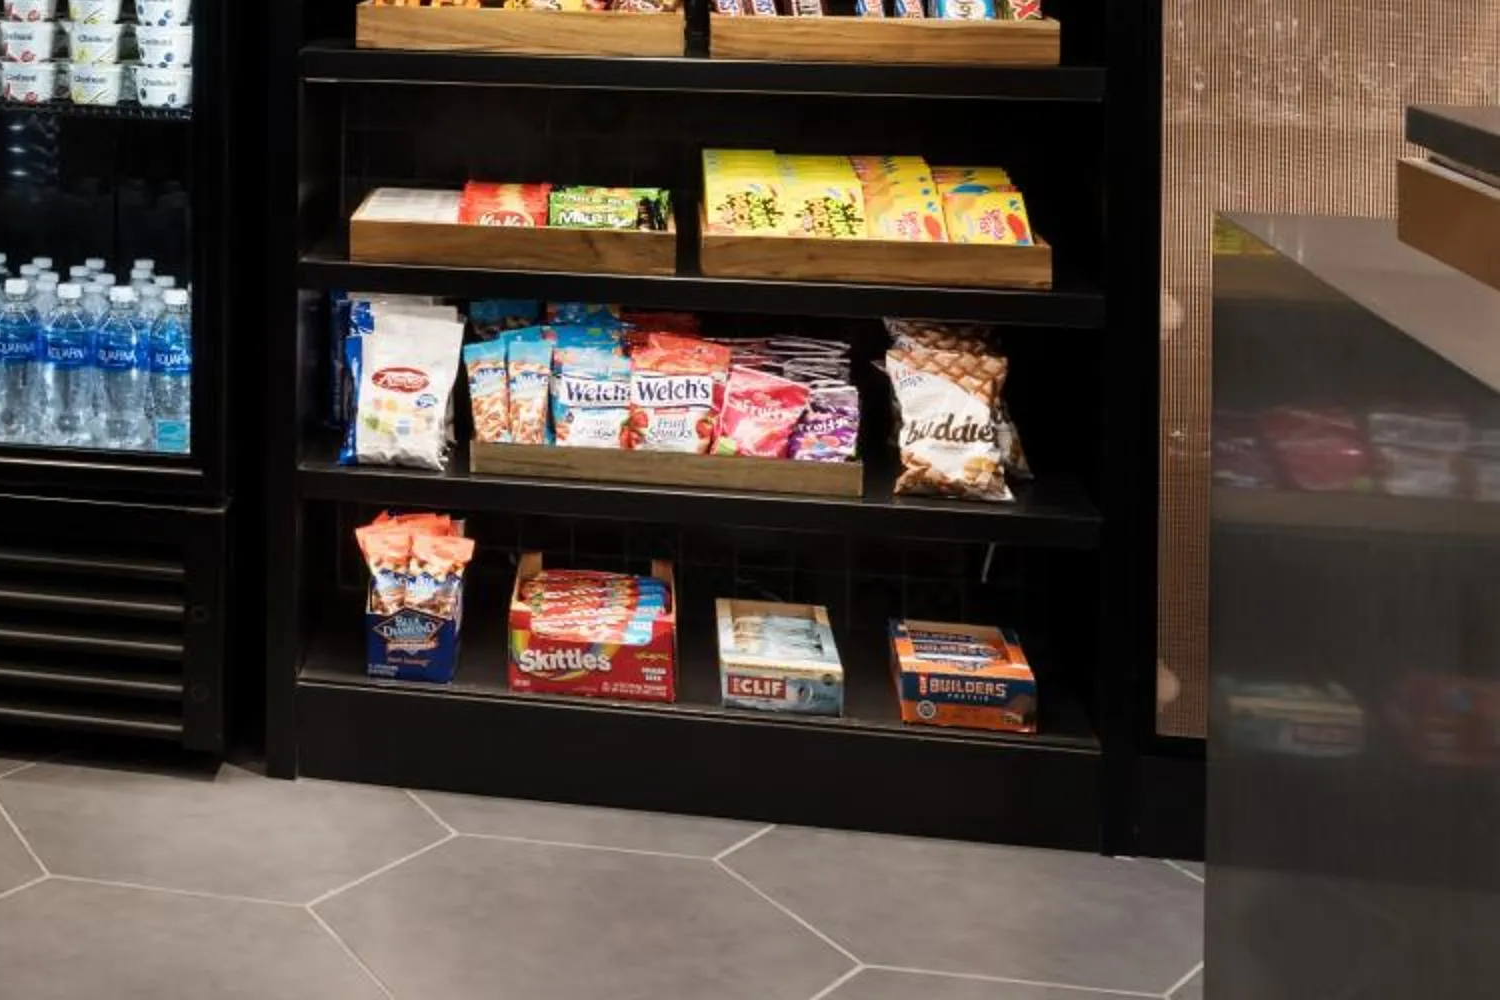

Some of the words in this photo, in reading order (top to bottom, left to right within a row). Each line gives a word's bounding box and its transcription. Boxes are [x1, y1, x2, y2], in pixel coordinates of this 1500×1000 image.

[636, 378, 710, 401] Welch's
[519, 647, 612, 674] Skittles
[741, 679, 784, 697] CLIF
[929, 676, 1009, 698] BUILDERS
